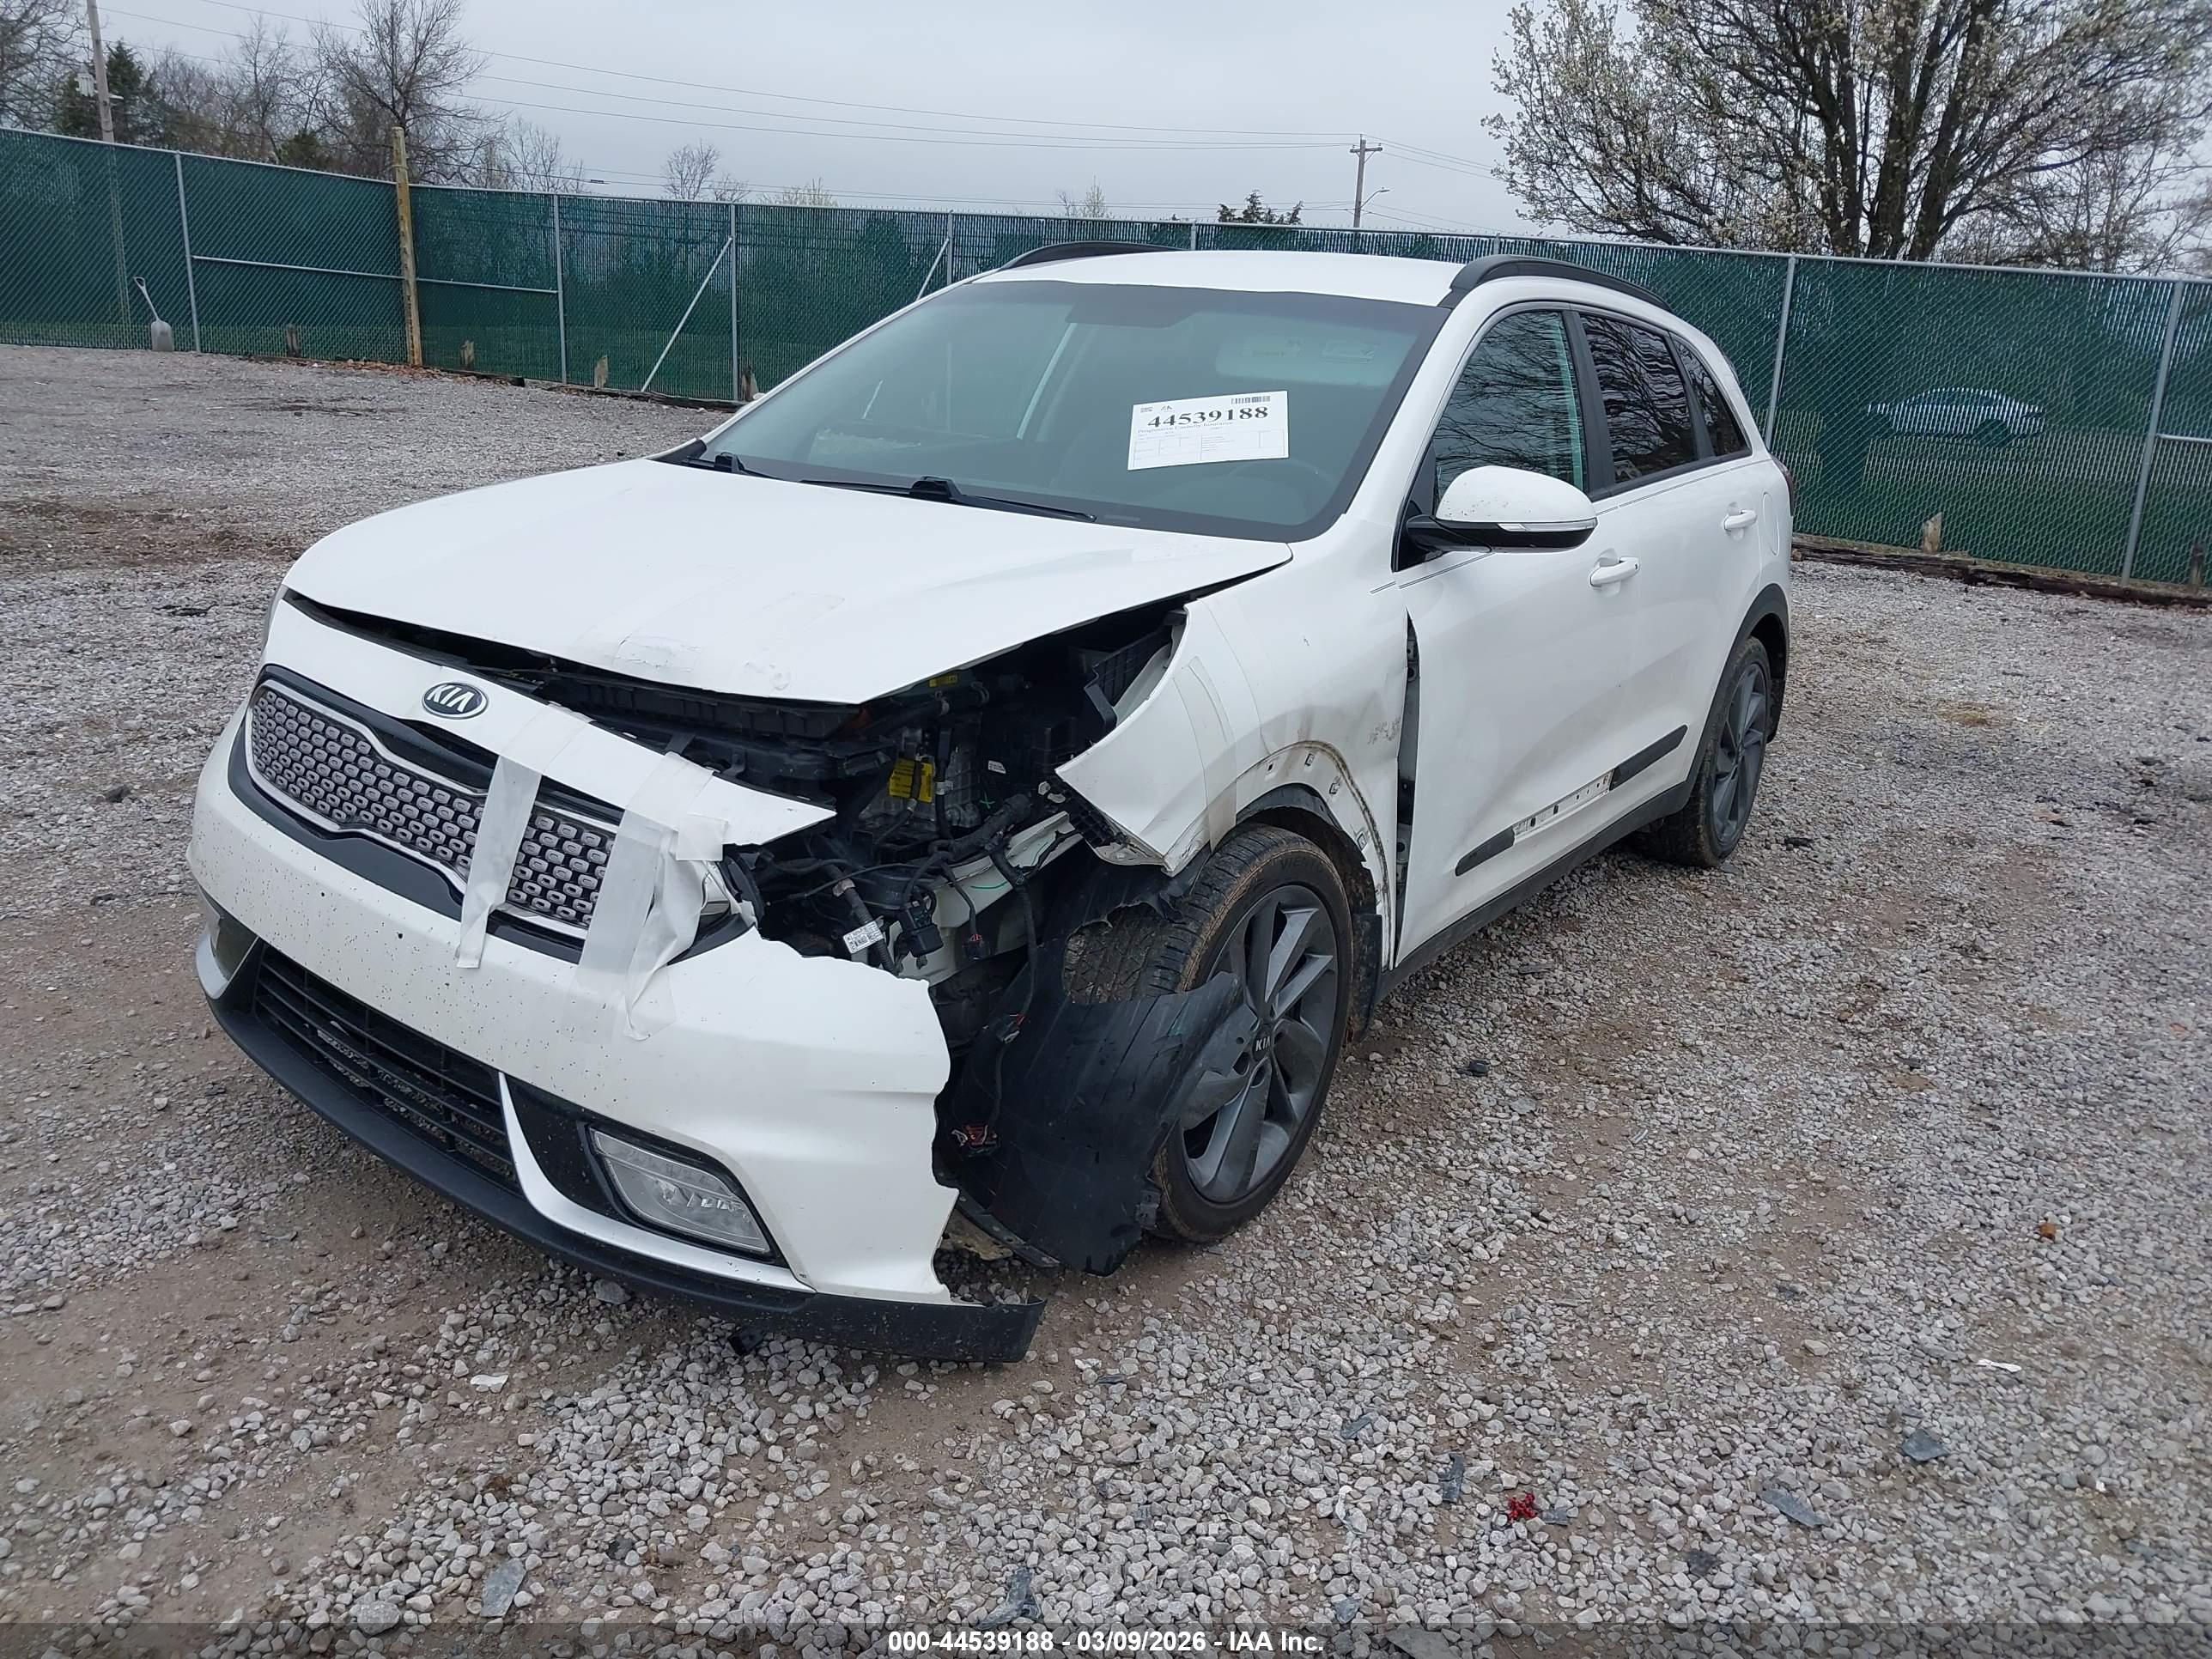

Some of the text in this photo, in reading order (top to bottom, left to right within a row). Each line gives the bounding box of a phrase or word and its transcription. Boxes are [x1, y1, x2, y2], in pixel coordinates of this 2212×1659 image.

[1147, 406, 1268, 428] 44539188
[427, 684, 474, 712] KIA
[1255, 1035, 1271, 1052] KIA
